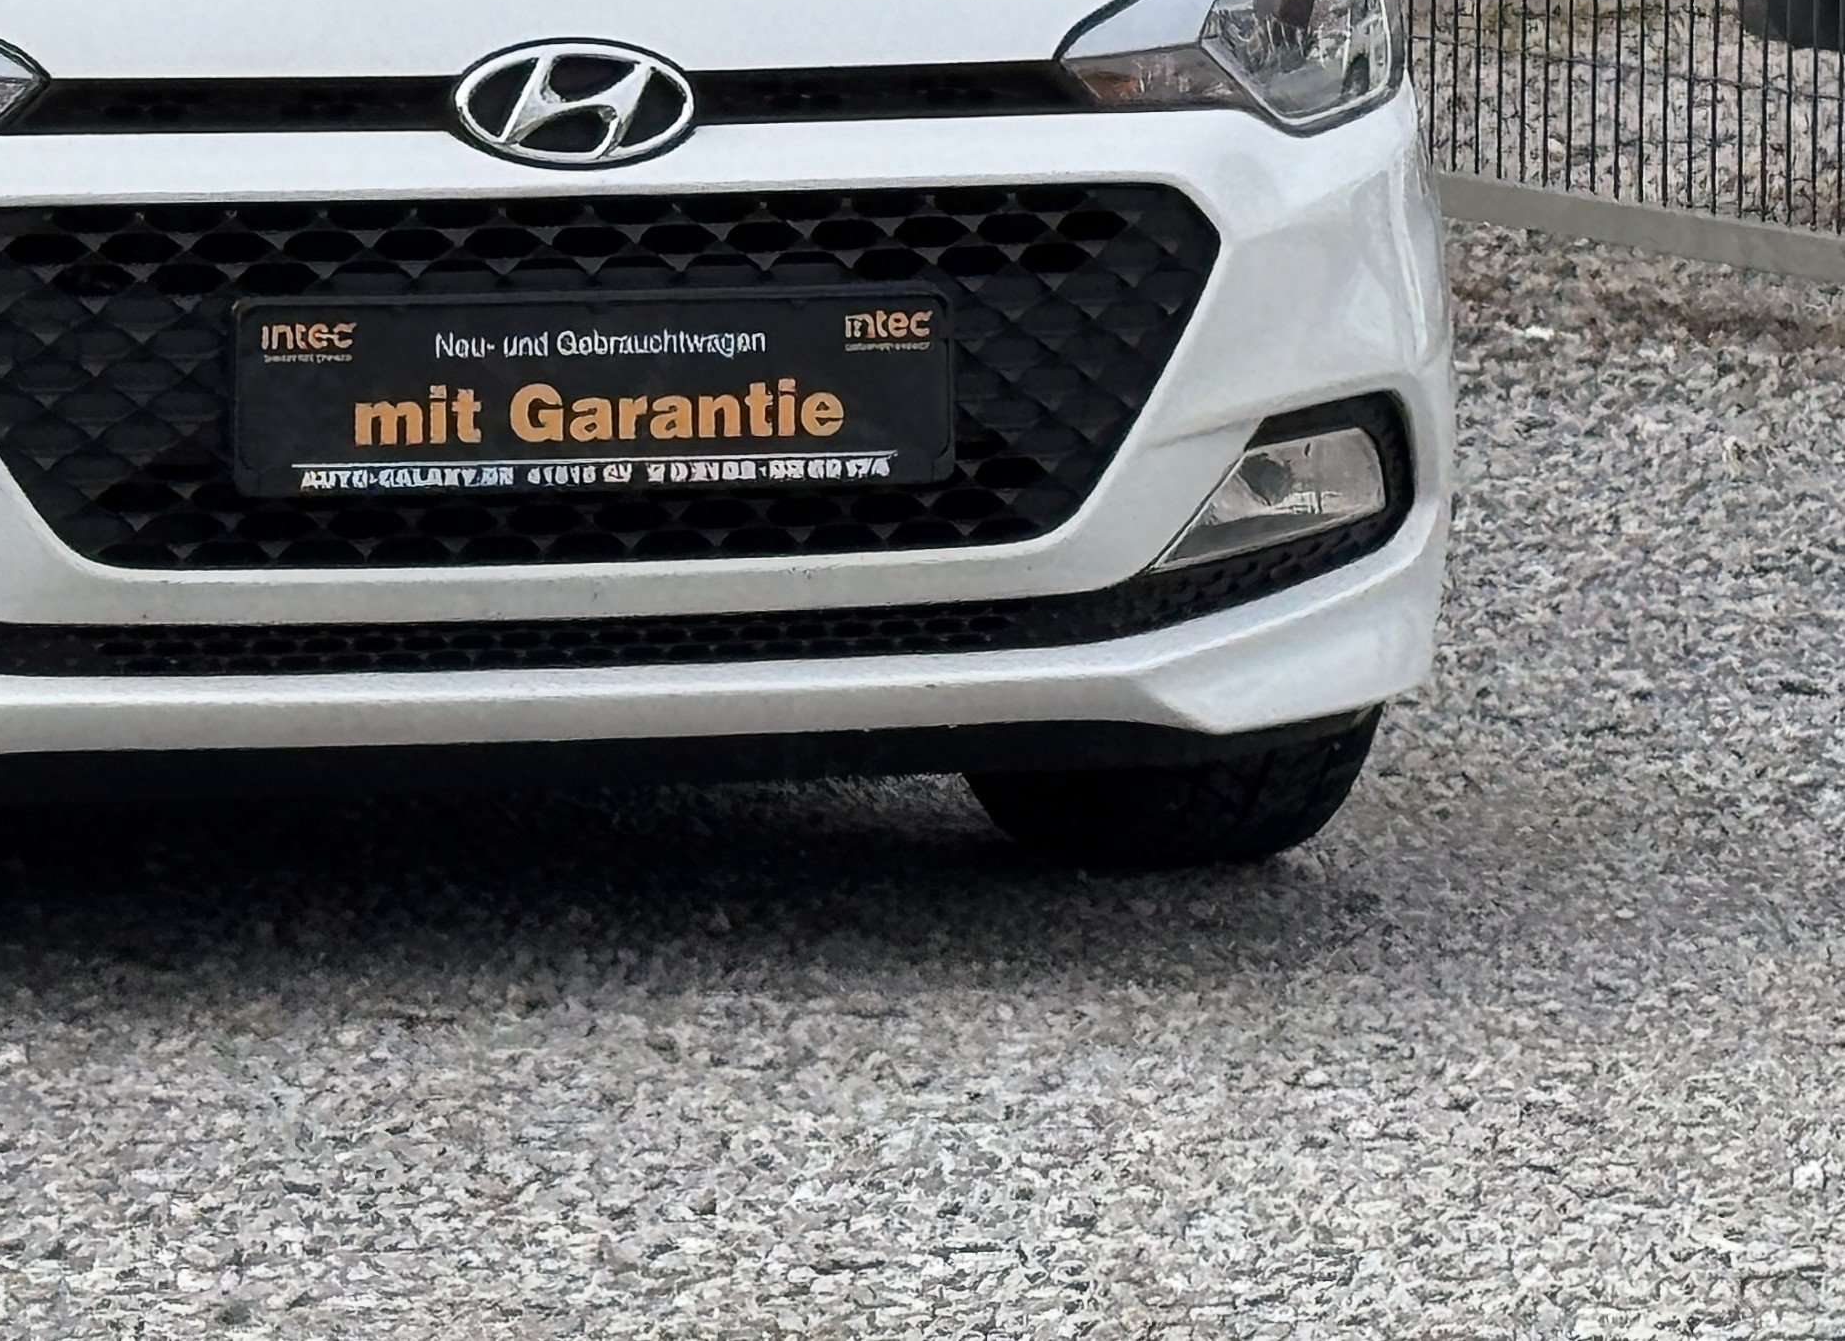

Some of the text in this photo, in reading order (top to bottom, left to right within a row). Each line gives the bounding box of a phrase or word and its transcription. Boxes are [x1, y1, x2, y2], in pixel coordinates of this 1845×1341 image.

[504, 332, 549, 357] und
[354, 378, 844, 446] mit Garantie
